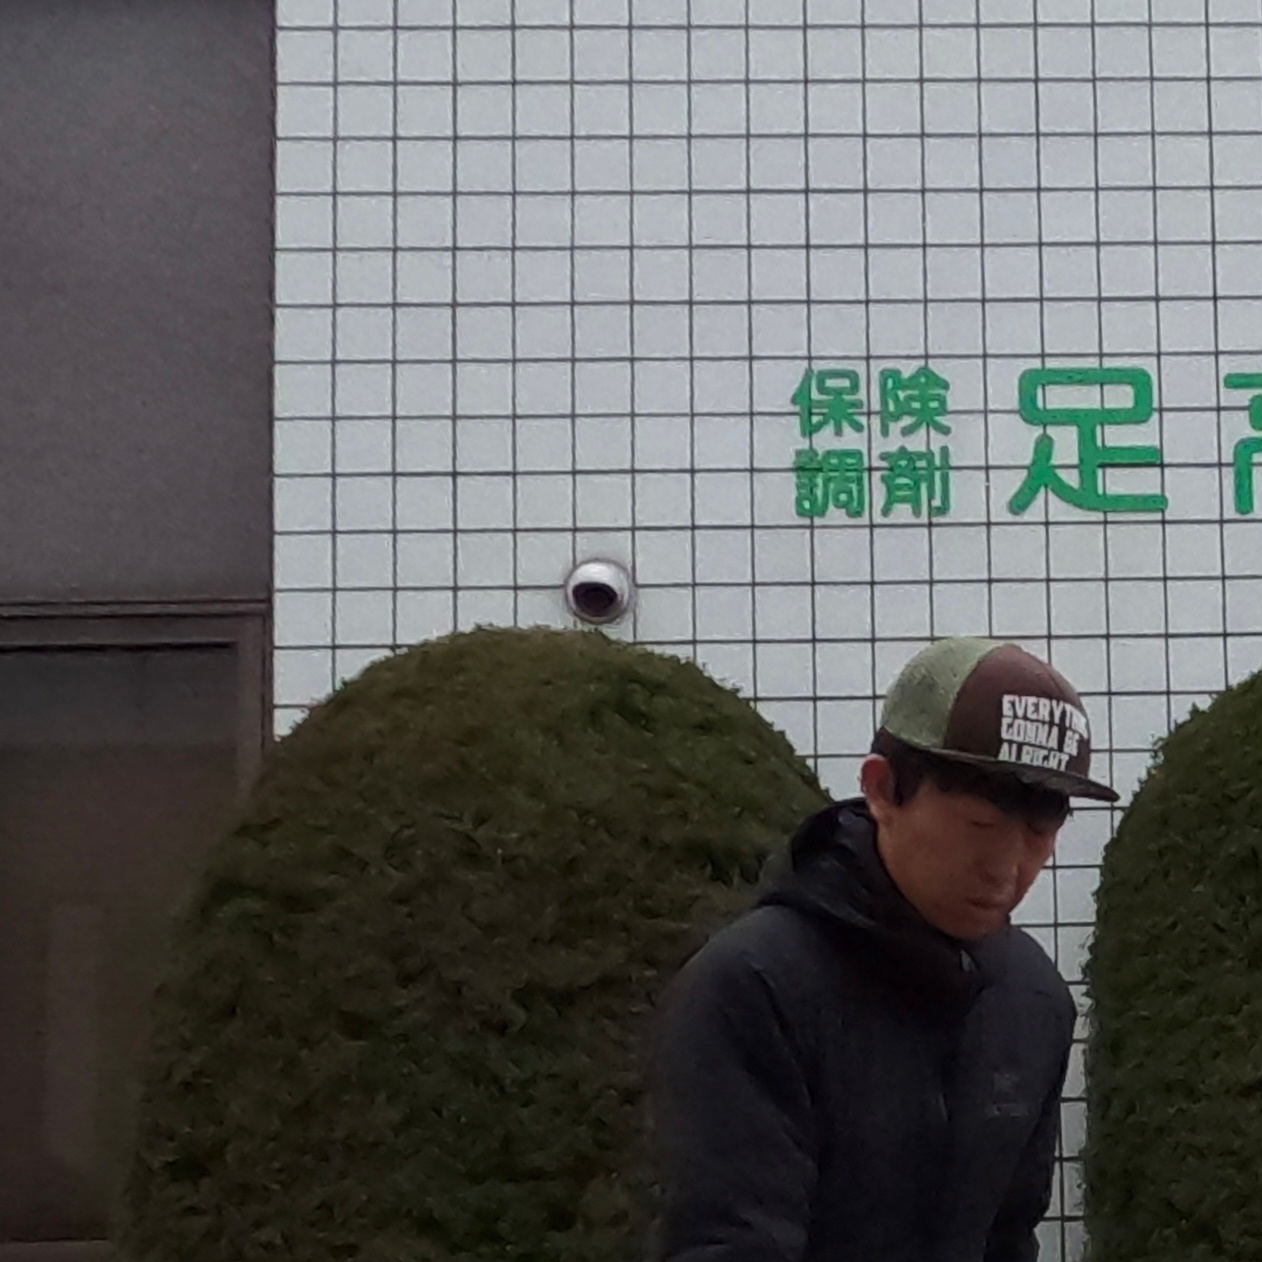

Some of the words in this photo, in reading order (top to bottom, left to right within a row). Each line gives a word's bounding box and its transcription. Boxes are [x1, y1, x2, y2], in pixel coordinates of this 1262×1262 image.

[790, 366, 952, 438] 保険
[792, 445, 951, 518] 調剤
[998, 741, 1070, 771] ALRIGHT
[1000, 717, 1059, 750] GONNA
